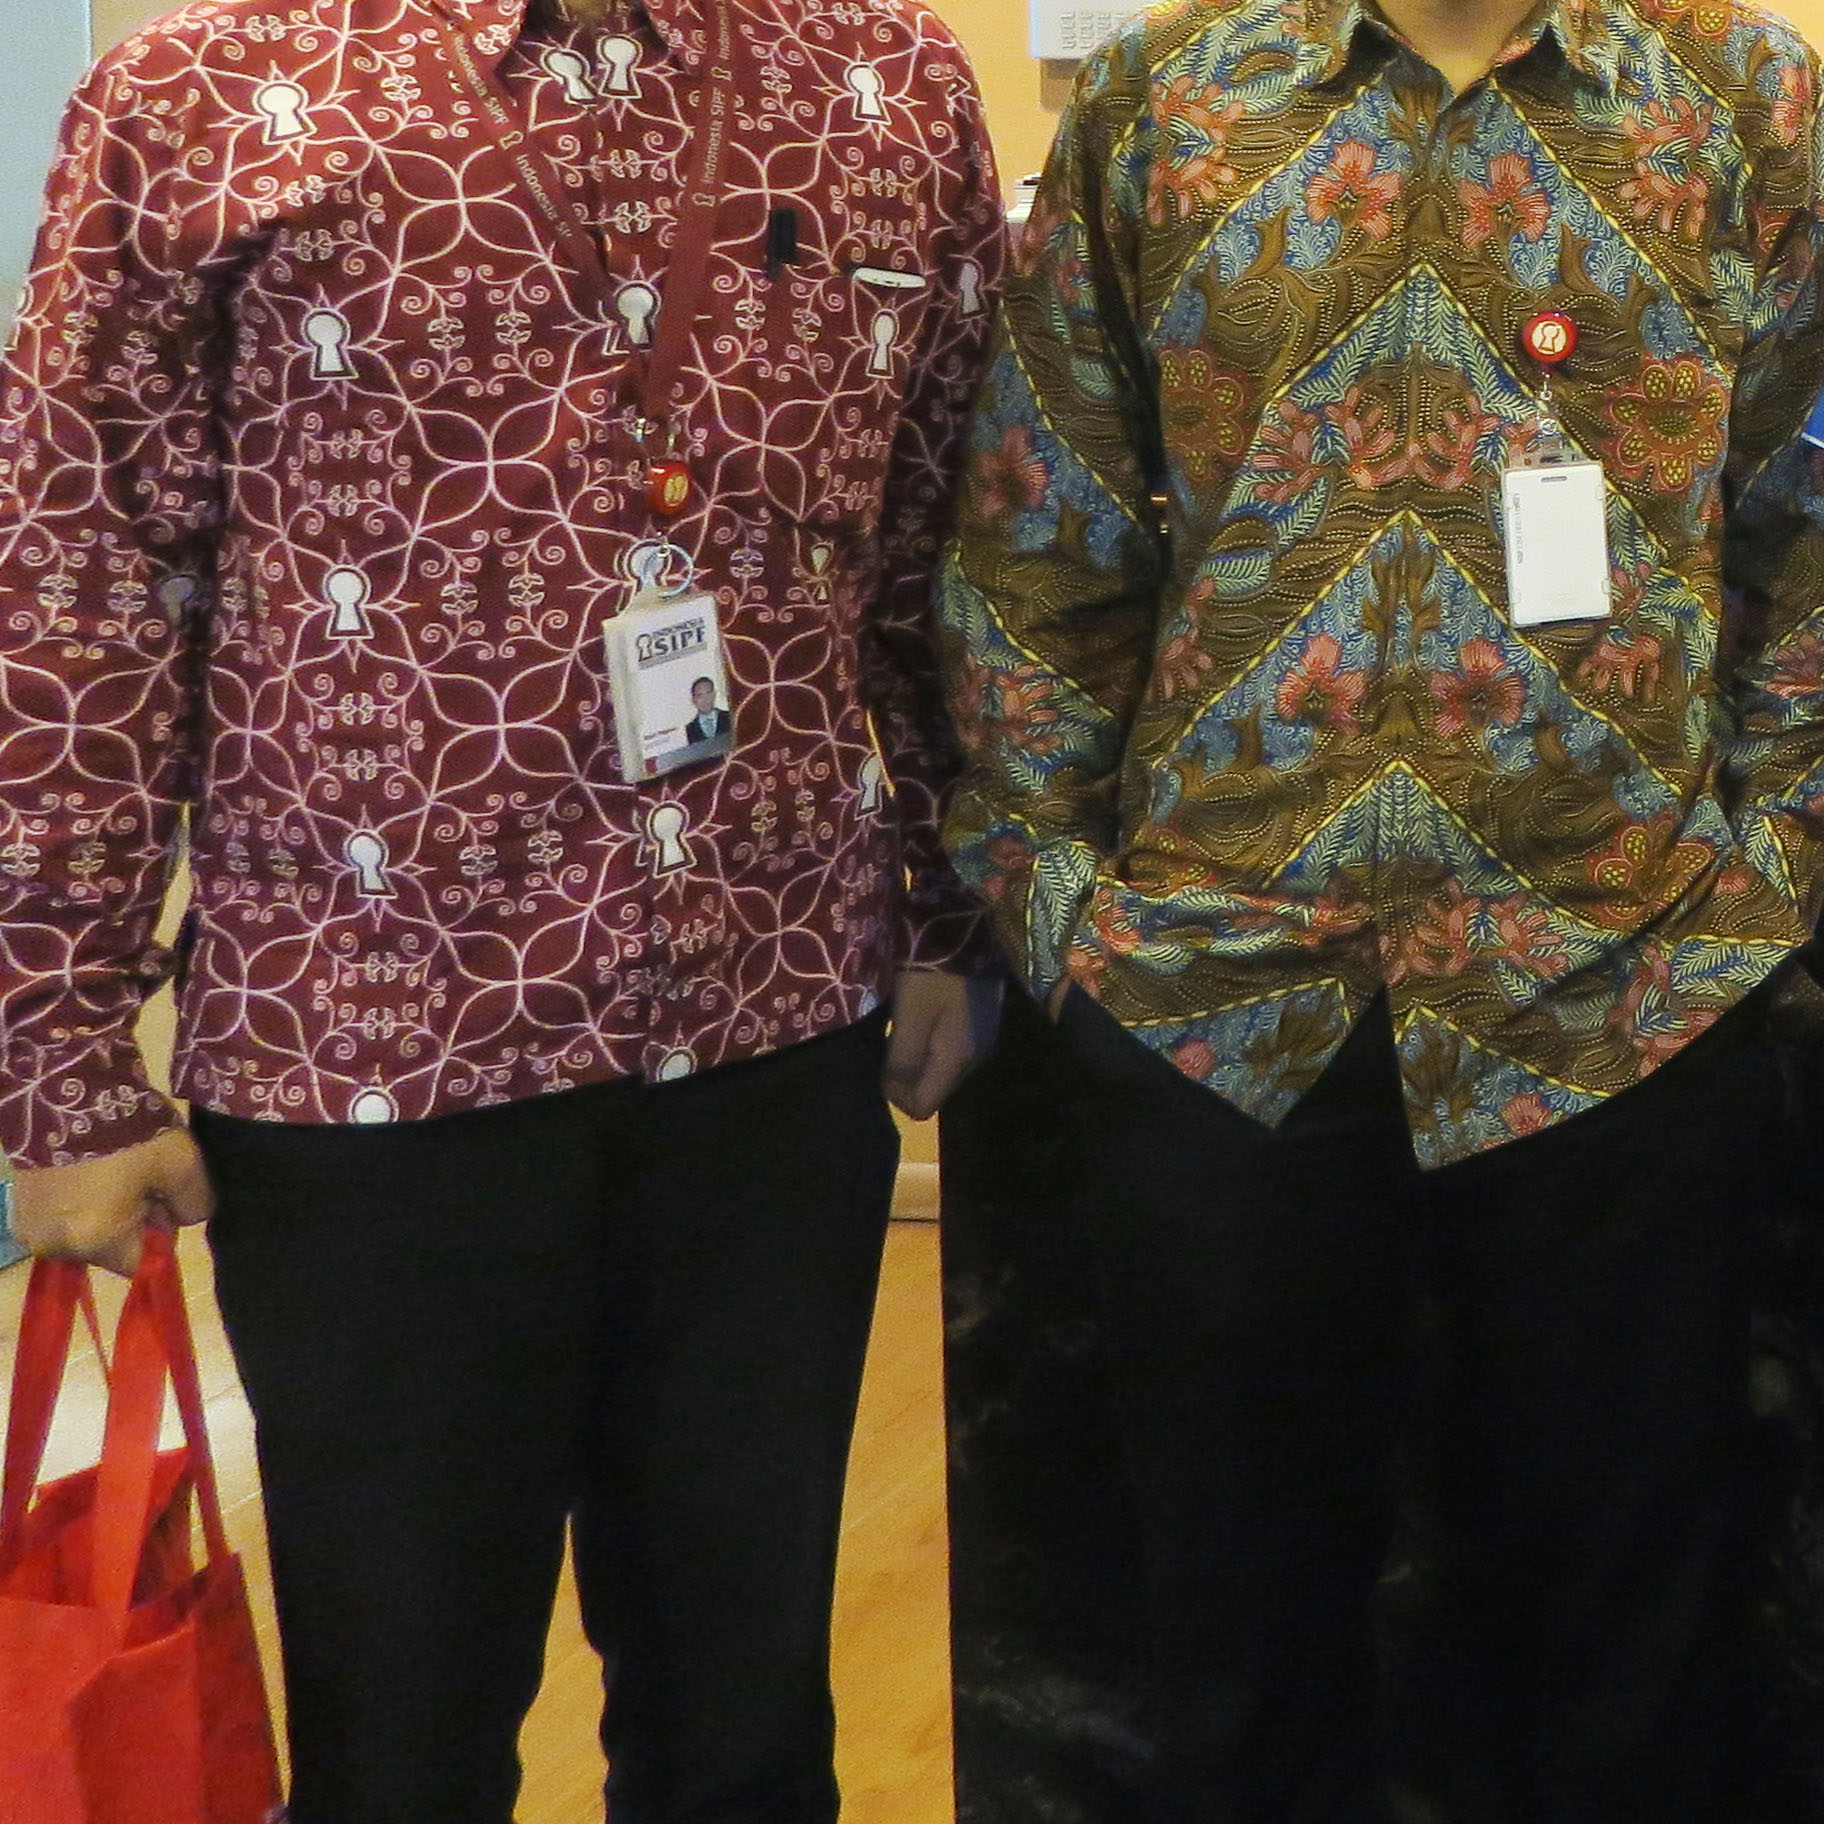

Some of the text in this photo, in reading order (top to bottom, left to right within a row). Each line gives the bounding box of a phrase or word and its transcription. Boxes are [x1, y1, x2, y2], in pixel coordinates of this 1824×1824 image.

[702, 86, 725, 184] Indonesia SIPF
[654, 627, 706, 657] SIPF
